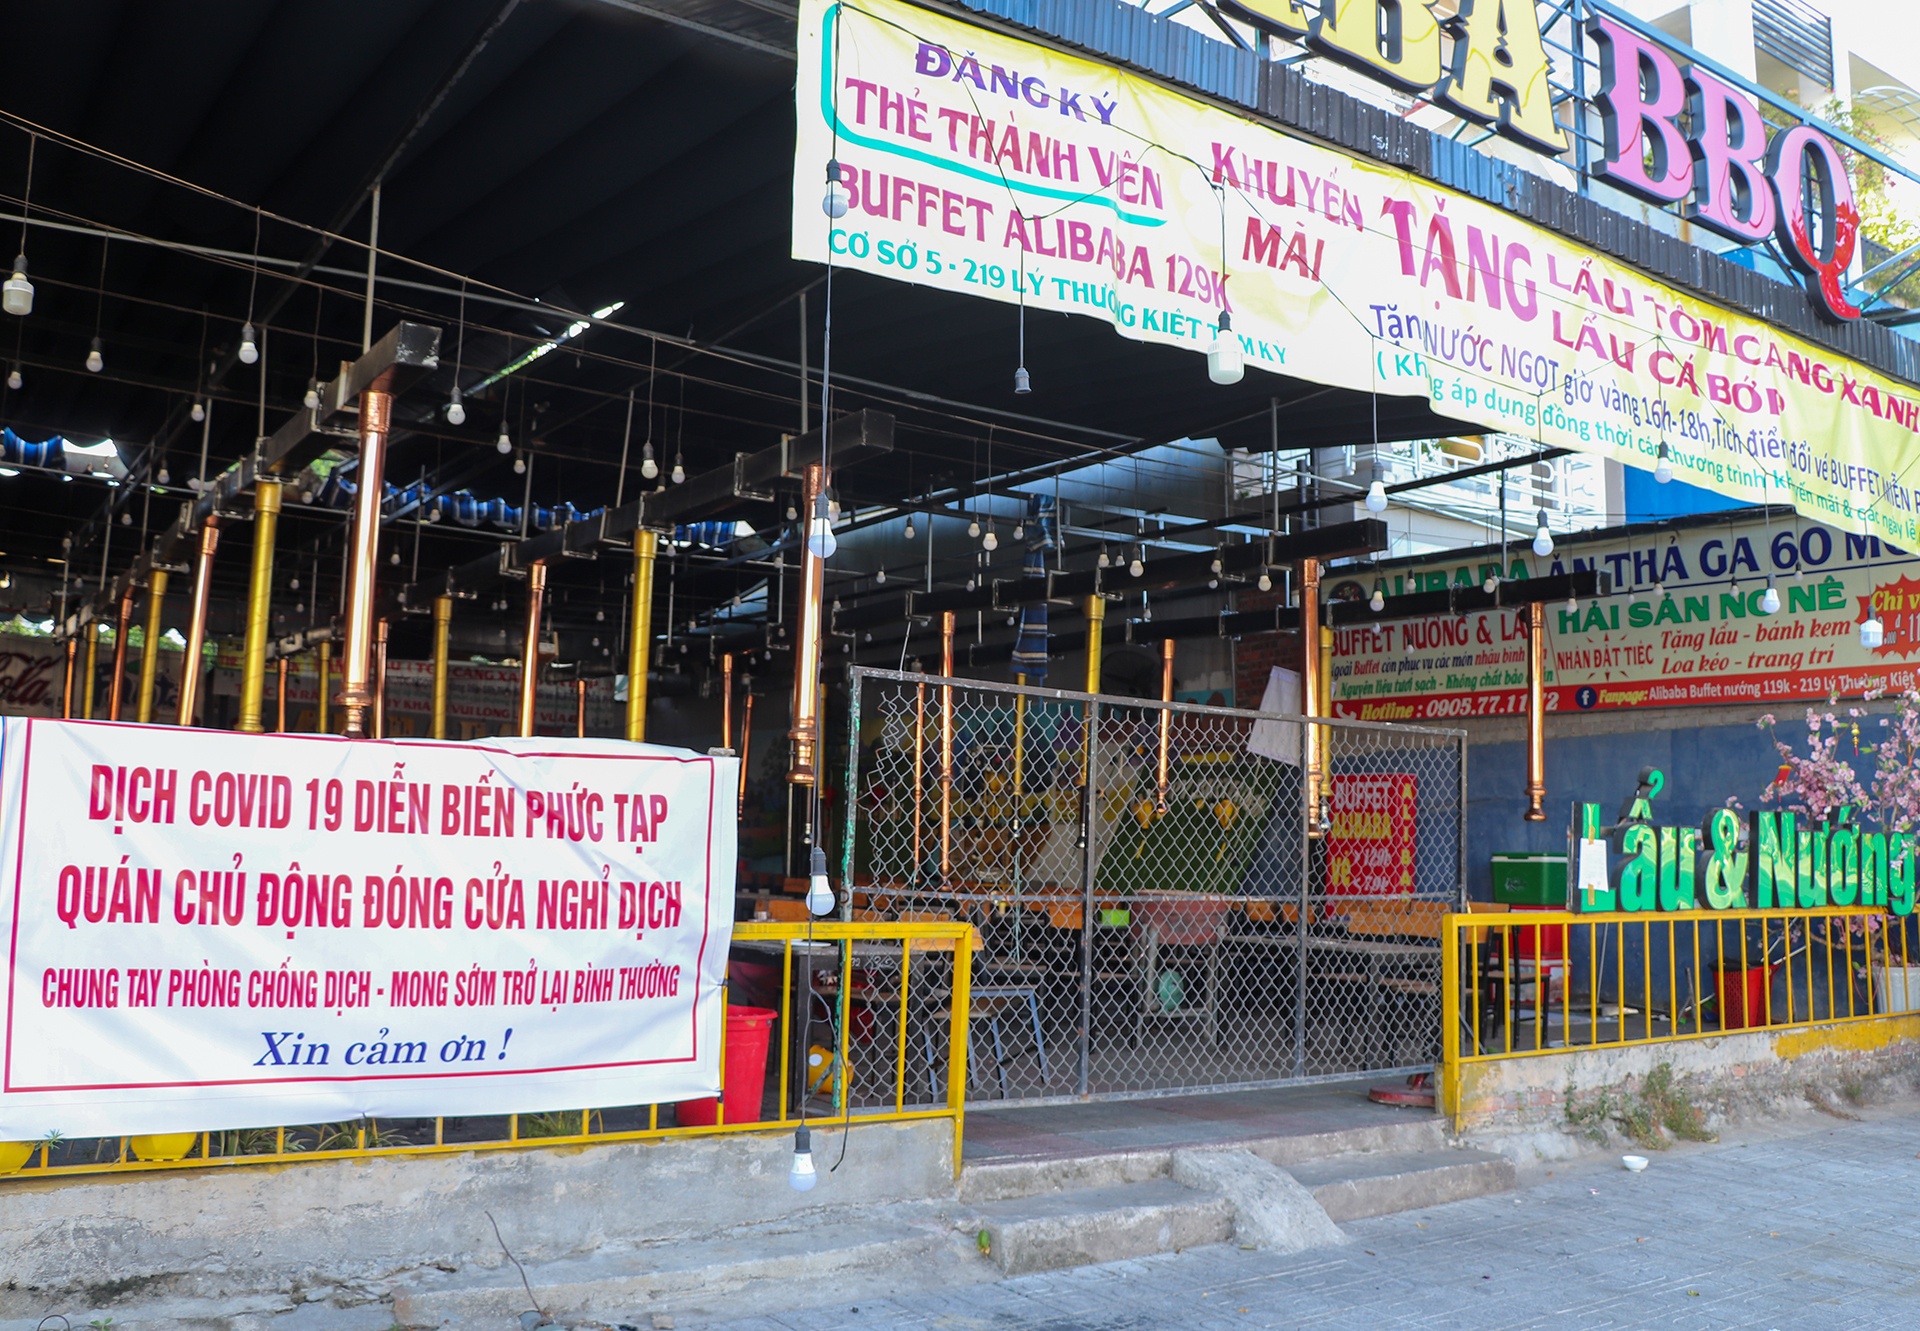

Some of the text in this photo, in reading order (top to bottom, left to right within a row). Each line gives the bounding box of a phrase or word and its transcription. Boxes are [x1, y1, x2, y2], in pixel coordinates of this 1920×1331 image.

[915, 43, 1118, 125] ĐĂNG KÝ
[845, 77, 932, 143] THẺ
[938, 107, 1080, 182] THÀNH
[1211, 143, 1363, 232] KHUYẾN
[1592, 17, 1860, 320] BBQ
[839, 163, 1233, 314] BUFFET ALIBABA 129K
[1242, 216, 1325, 283] MÃI
[1380, 195, 1538, 322] TẶNG
[828, 229, 869, 259] CƠ
[877, 239, 918, 270] SỞ
[926, 250, 942, 274] 5
[963, 258, 1005, 288] 219
[1012, 267, 1044, 296] LÝ
[1142, 308, 1202, 340] KIỆT
[1207, 323, 1255, 356] TM
[1648, 350, 1700, 397] CÁ
[1840, 373, 1920, 433] XANH
[1422, 320, 1493, 372] NƯỚC
[1500, 344, 1559, 395] NGỌT
[1564, 369, 1594, 405] giờ
[1599, 379, 1641, 427] vàng
[1790, 440, 1811, 474] đổi
[1815, 453, 1828, 481] vé
[1831, 458, 1880, 497] BUFFET
[1451, 377, 1477, 409] áp
[1484, 388, 1536, 426] dụng
[1543, 402, 1589, 442] đồng
[1595, 420, 1633, 450] thời
[1726, 463, 1766, 488] trình
[1817, 493, 1840, 514] mãi
[1842, 501, 1853, 518] &
[1857, 504, 1880, 525] các
[1905, 518, 1916, 540] lễ
[1604, 535, 1689, 587] THẢ
[1699, 536, 1760, 577] GA
[1771, 526, 1833, 569] 60
[1558, 600, 1620, 635] HẢI
[1628, 592, 1718, 627] SẢN
[1788, 575, 1847, 613] NÊ
[1871, 588, 1903, 611] Chỉ
[1331, 625, 1395, 657] BUFFET
[1476, 615, 1493, 645] &
[1354, 658, 1380, 674] Buffet
[1381, 658, 1397, 673] còn
[1398, 655, 1420, 676] phục
[1422, 658, 1433, 674] vụ
[1435, 652, 1450, 669] các
[1452, 651, 1473, 667] món
[1475, 648, 1500, 669] nhậu
[1502, 646, 1525, 663] bình
[1557, 646, 1591, 672] NHẬN
[1624, 640, 1654, 669] TIỆC
[1661, 630, 1705, 654] Tặng
[1756, 619, 1804, 643] bánh
[1810, 618, 1850, 638] kem
[1662, 643, 1835, 674] Loa kéo trang trí
[1341, 681, 1374, 699] Nguyên
[1375, 679, 1392, 698] liệu
[1415, 675, 1436, 694] sạch
[1445, 671, 1477, 692] Không
[1479, 668, 1502, 687] chất
[1504, 668, 1523, 685] bảo
[1360, 701, 1414, 720] Hotline
[1599, 689, 1648, 705] Fanpage:
[1649, 684, 1687, 701] Alibaba
[1690, 681, 1721, 698] Buffet
[1724, 679, 1761, 697] nướng
[1763, 679, 1790, 694] 119k
[1800, 677, 1820, 692] 219
[1824, 675, 1836, 693] Lý
[1890, 671, 1915, 688] Kiệt
[89, 761, 668, 854] DỊCH COVID 19 DIỄN BIẾN PHỨC TẠP
[1335, 781, 1391, 809] BUFFET
[1576, 768, 1695, 912] Lẩu
[1704, 807, 1749, 910] &
[1752, 806, 1915, 916] Nướng
[57, 852, 682, 941] QUÁN CHỦ ĐỘNG ĐÓNG CỬA NGHỈ DỊCH
[42, 968, 120, 1009] CHUNG
[126, 969, 163, 1008] TAY
[167, 959, 242, 1008] PHÒNG
[248, 956, 318, 1009] CHỐNG
[324, 970, 372, 1016] DỊCH
[390, 971, 449, 1008] MONG
[454, 962, 497, 1007] SỚM
[502, 958, 538, 1006] TRỞ
[541, 970, 568, 1012] LẠI
[572, 961, 614, 1004] BÌNH
[619, 959, 681, 1001] THƯỜNG
[253, 1028, 513, 1067] Xin cảm ơn !
